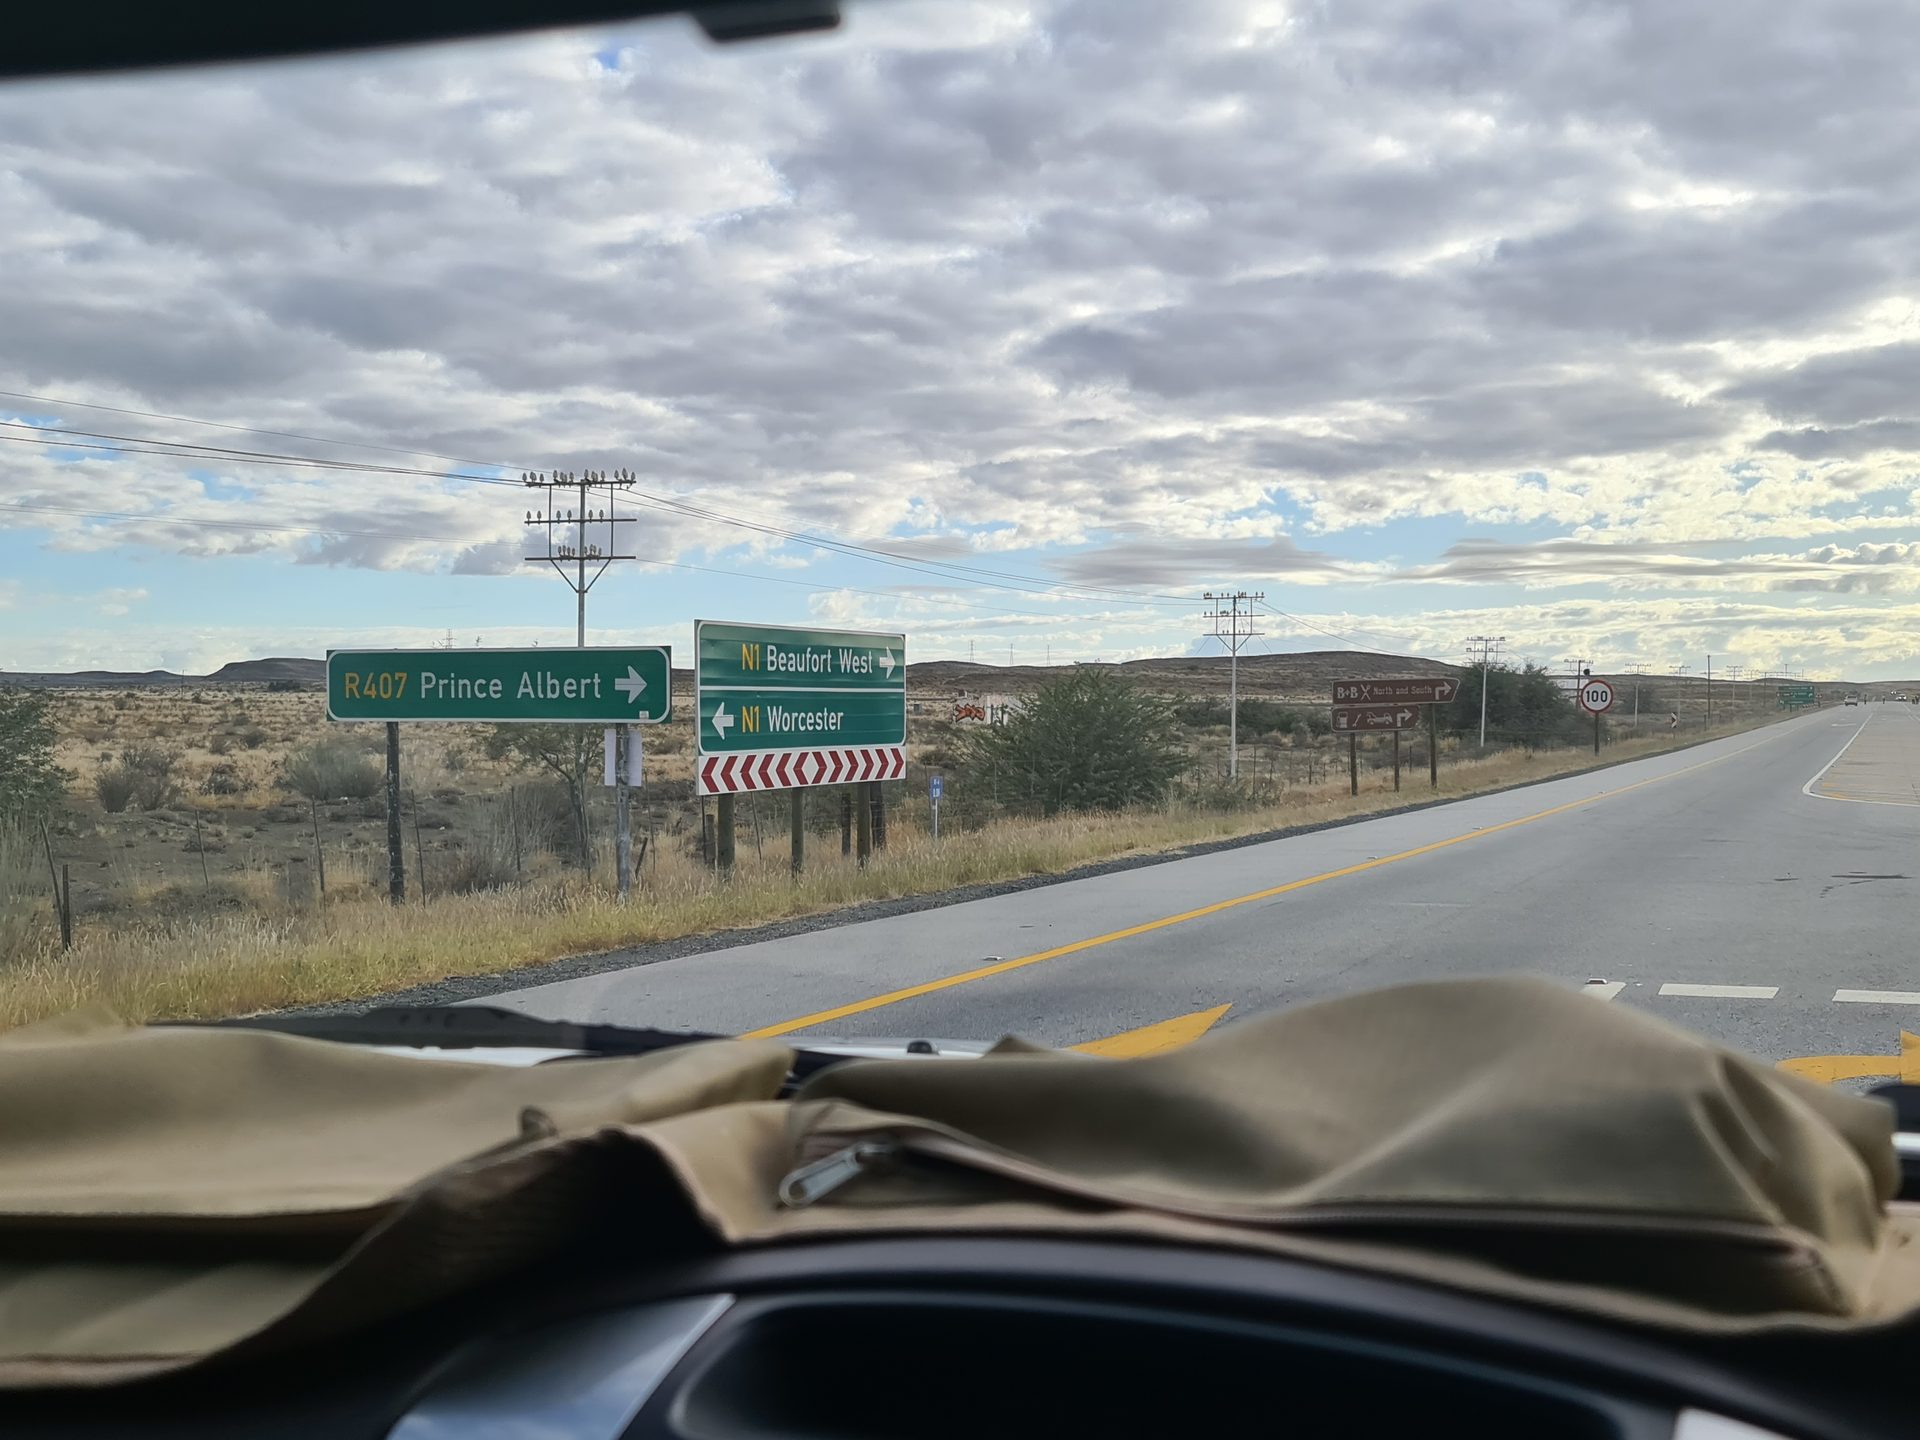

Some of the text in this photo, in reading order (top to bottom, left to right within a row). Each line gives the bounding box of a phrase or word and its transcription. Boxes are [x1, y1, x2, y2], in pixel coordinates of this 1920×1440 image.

[742, 643, 873, 674] N1 Beaufort West
[344, 671, 601, 699] R407 Prince Albert
[1337, 685, 1432, 699] B+B North and South
[1586, 690, 1608, 703] 100
[742, 705, 844, 733] N1 Worcester
